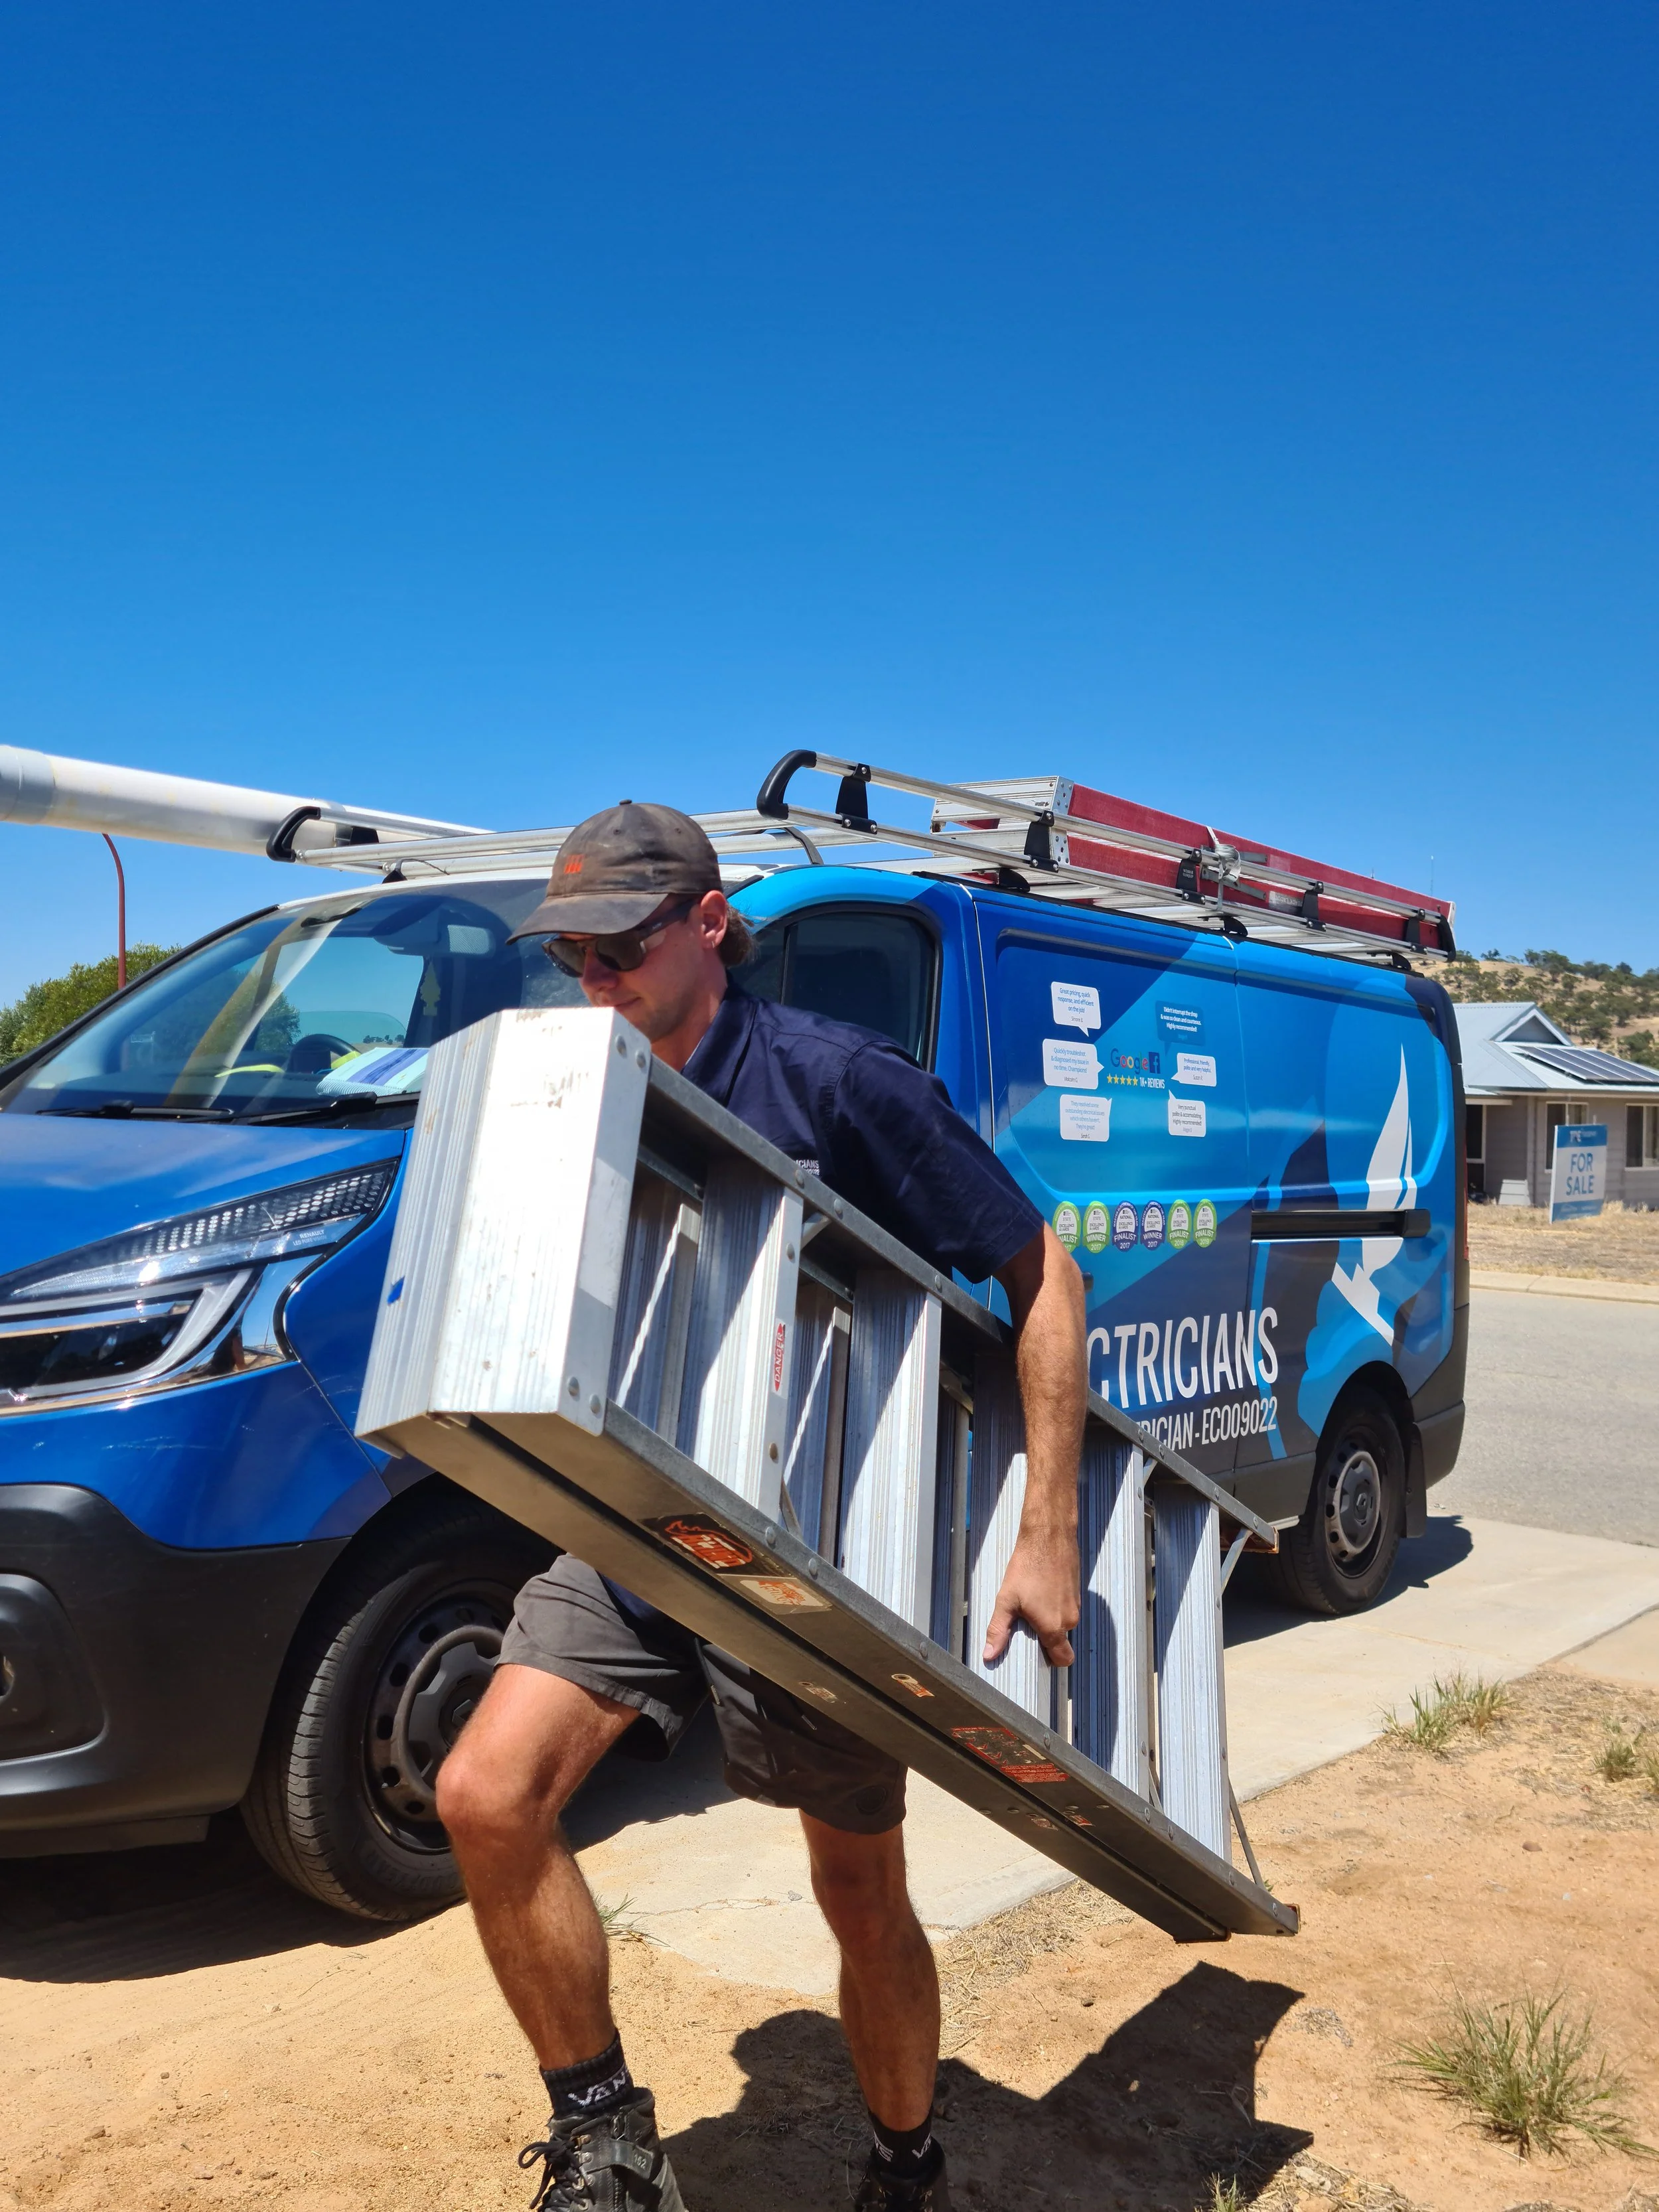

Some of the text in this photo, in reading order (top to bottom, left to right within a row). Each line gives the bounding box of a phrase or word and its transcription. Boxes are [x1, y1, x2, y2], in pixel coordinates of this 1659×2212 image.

[1053, 1047, 1066, 1056] Quickly
[1111, 1048, 1148, 1075] Google
[1148, 1078, 1165, 1089] REVIEWS
[1570, 1153, 1593, 1173] FOR
[1566, 1175, 1595, 1195] SALE
[299, 1230, 324, 1238] RENAULT
[1087, 1234, 1106, 1243] WINNER
[1114, 1233, 1136, 1242] FINALIST
[1170, 1230, 1189, 1240] FINALIST
[1195, 1229, 1214, 1239] FINALIST
[775, 1333, 783, 1382] DANGER
[1086, 1307, 1278, 1408] CTRICIANS
[1137, 1412, 1194, 1451] RICIAN
